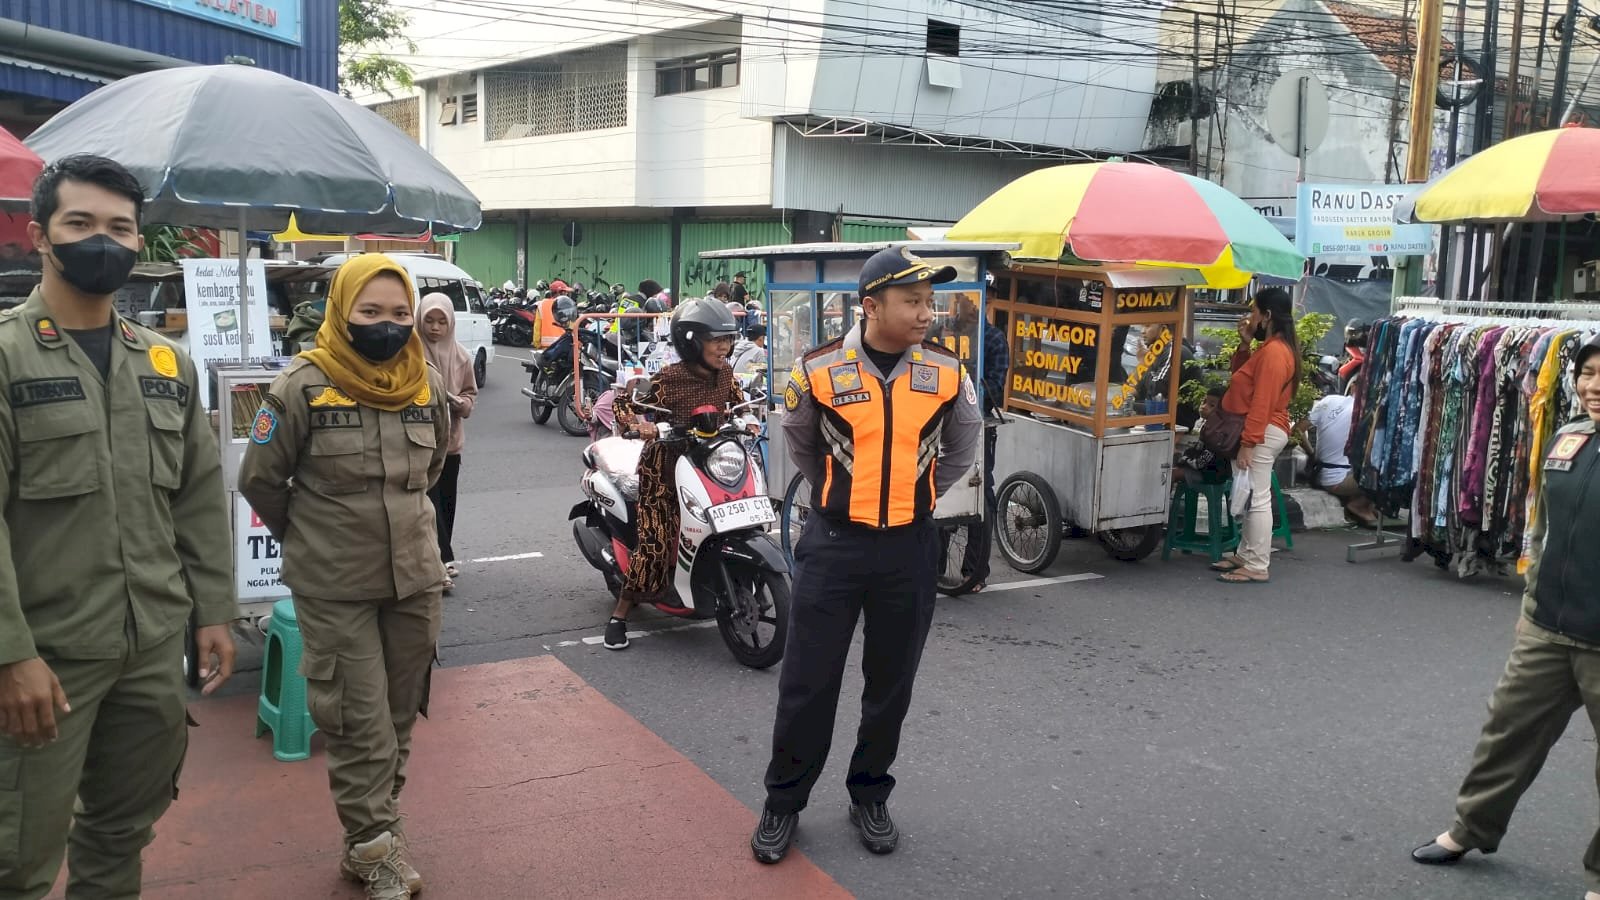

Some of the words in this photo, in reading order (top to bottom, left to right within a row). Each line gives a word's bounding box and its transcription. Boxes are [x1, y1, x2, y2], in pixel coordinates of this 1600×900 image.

[1312, 189, 1355, 210] RANU
[196, 282, 235, 301] kembang
[1117, 291, 1175, 309] SOMAY
[203, 332, 223, 346] susu
[224, 329, 255, 345] kedai
[1016, 320, 1096, 347] BATAGOR
[1025, 350, 1082, 375] SOMAY
[1111, 327, 1173, 410] BATAGOR
[834, 394, 868, 405] DESTA
[1012, 374, 1092, 408] BANDUNG
[318, 411, 351, 426] OKY
[712, 507, 726, 520] AD
[726, 501, 751, 516] 2581
[753, 498, 771, 510] CYC
[247, 535, 283, 560] TE
